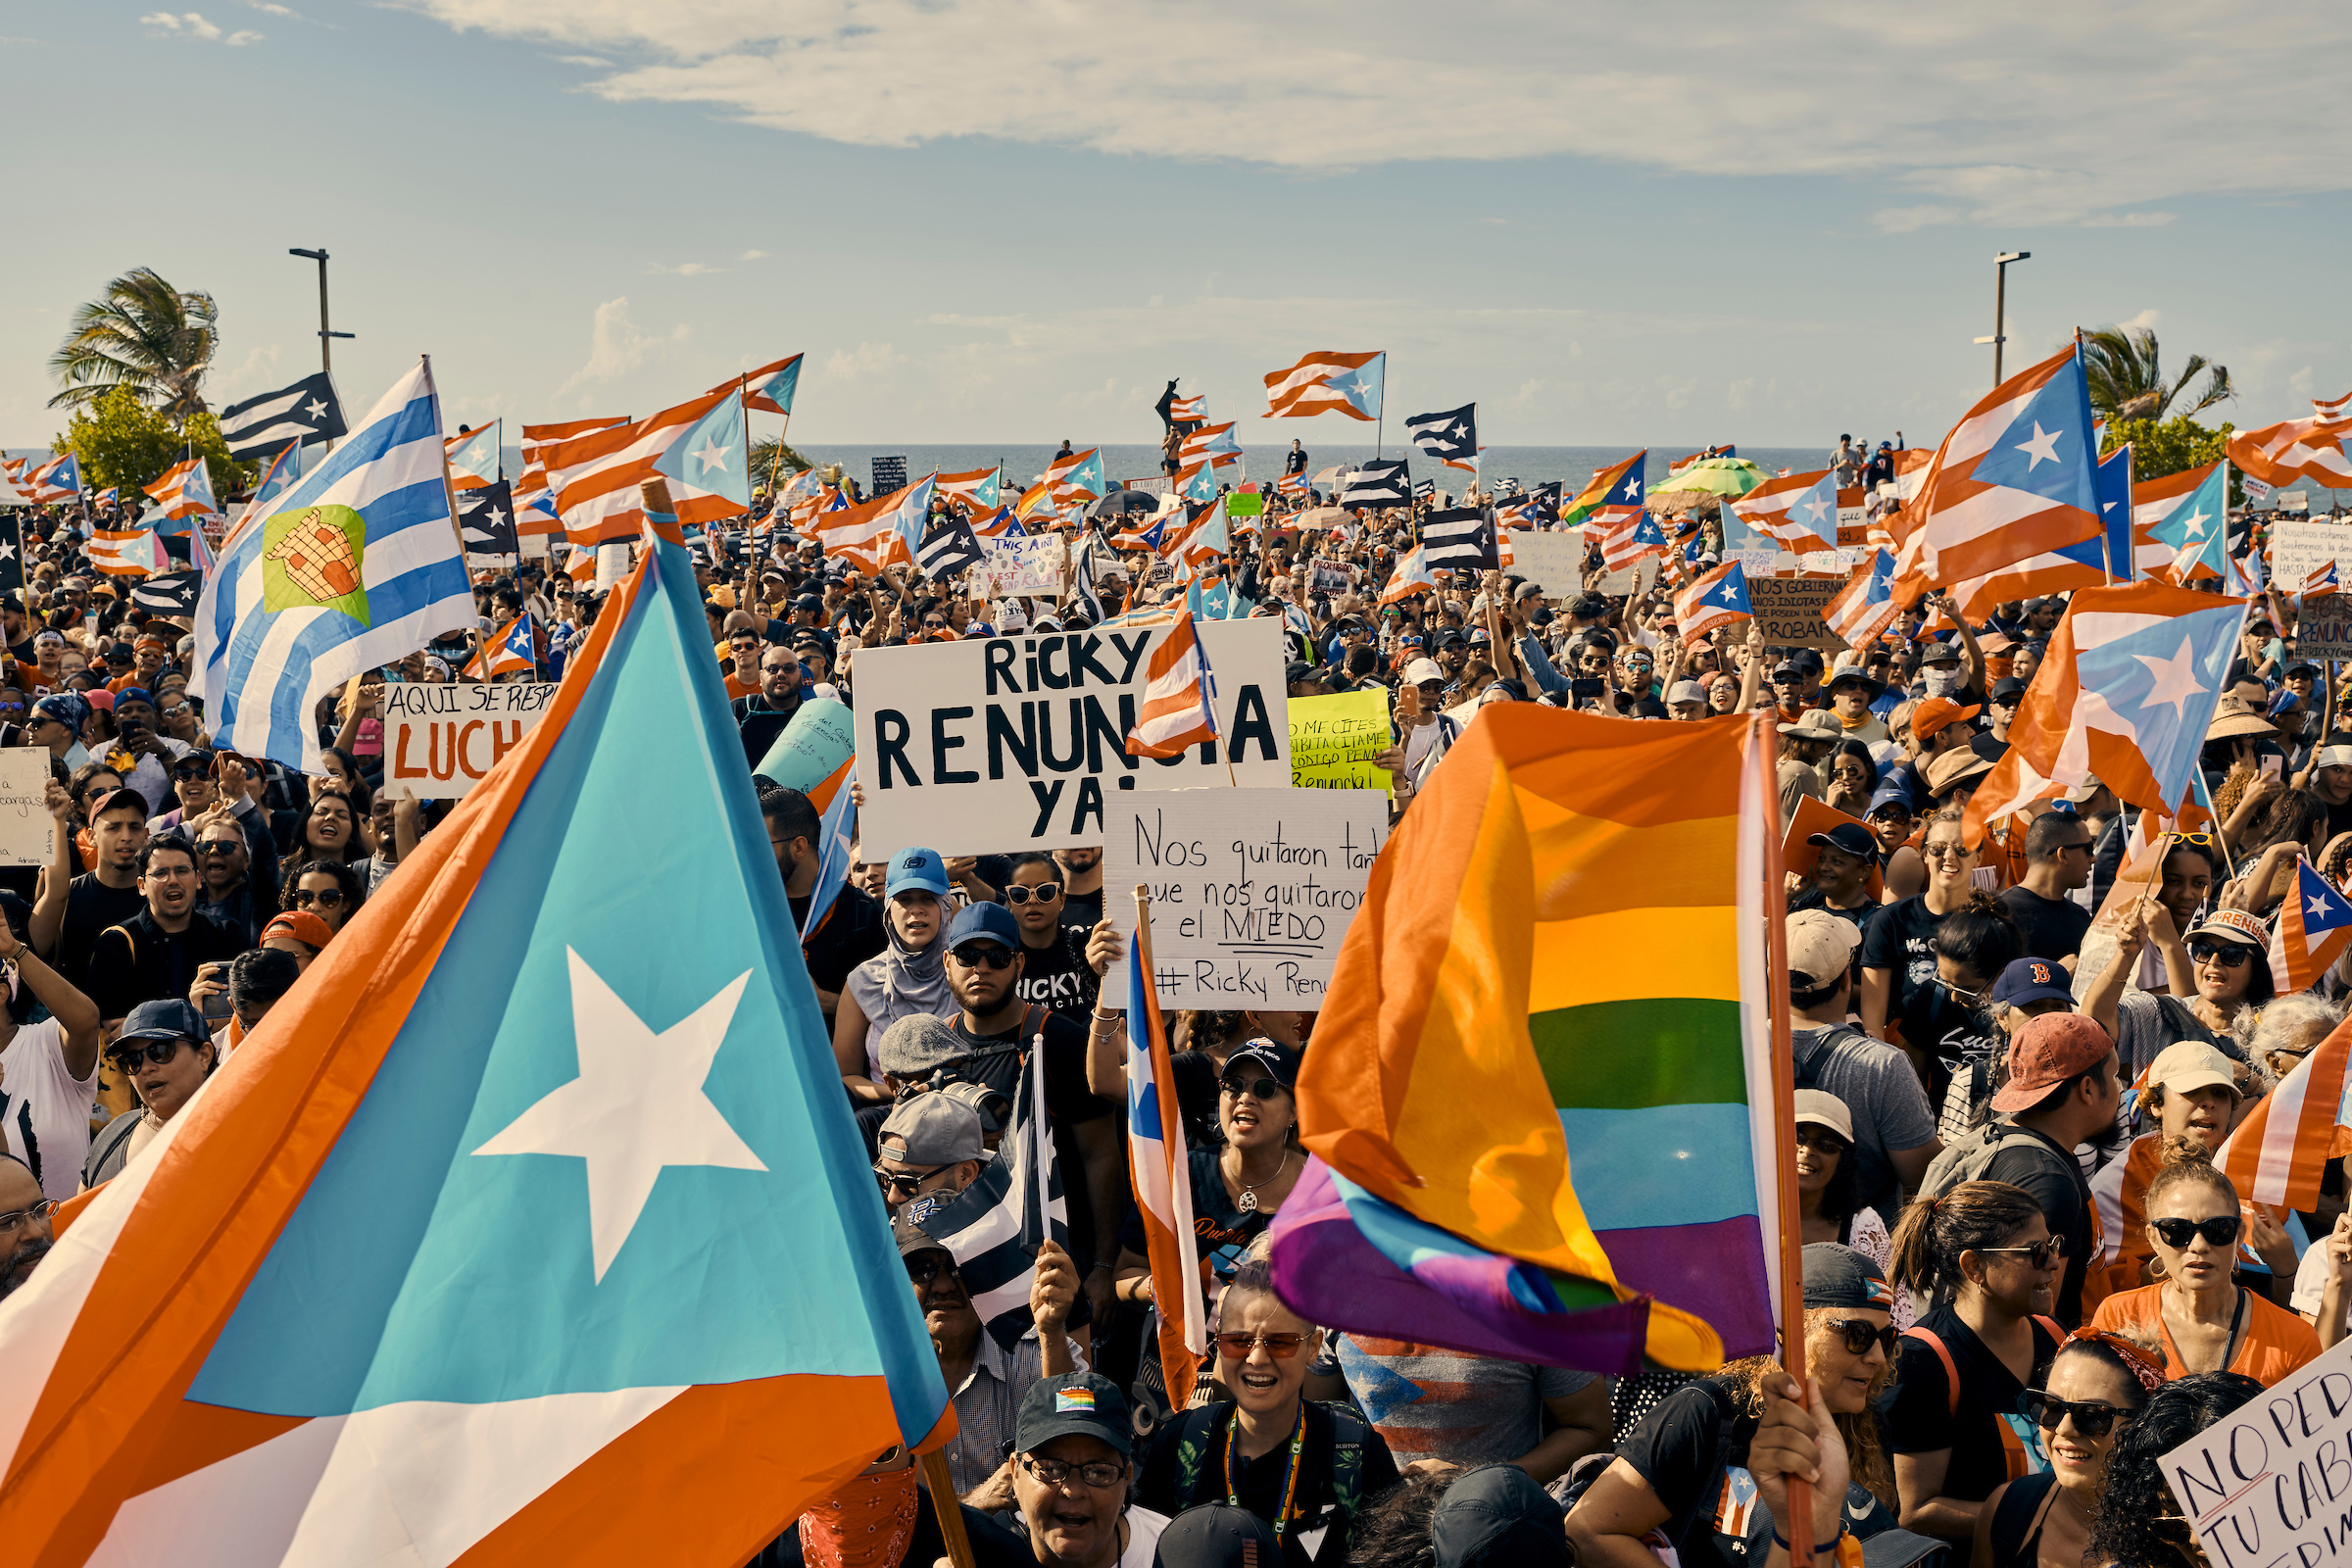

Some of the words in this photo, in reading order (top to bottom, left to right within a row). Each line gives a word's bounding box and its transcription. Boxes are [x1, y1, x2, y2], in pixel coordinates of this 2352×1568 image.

[2280, 525, 2318, 539] Nosotros
[2321, 527, 2350, 541] estamos
[992, 539, 1023, 554] THIS
[1028, 536, 1054, 552] AINT
[2280, 540, 2323, 551] Sostenemos
[987, 572, 1018, 583] BEST
[2279, 564, 2306, 575] HASTA
[1749, 579, 1783, 594] NOS
[386, 686, 461, 717] AQUI
[468, 686, 503, 711] SE
[1304, 720, 1329, 734] ME
[1291, 753, 1340, 768] CÓDIGO
[1346, 748, 1377, 762] PENA
[1135, 808, 1207, 866] Nos
[1232, 821, 1327, 886] quitaron
[1339, 821, 1380, 869] tant
[1179, 909, 1202, 938] el
[1224, 907, 1325, 942] MIEDO
[2030, 962, 2051, 984] B
[1193, 1217, 1249, 1246] Puerto
[1291, 1442, 1301, 1454] TD
[2176, 1425, 2268, 1519] NO
[1274, 1521, 1286, 1533] TD
[2201, 1506, 2260, 1568] TU
